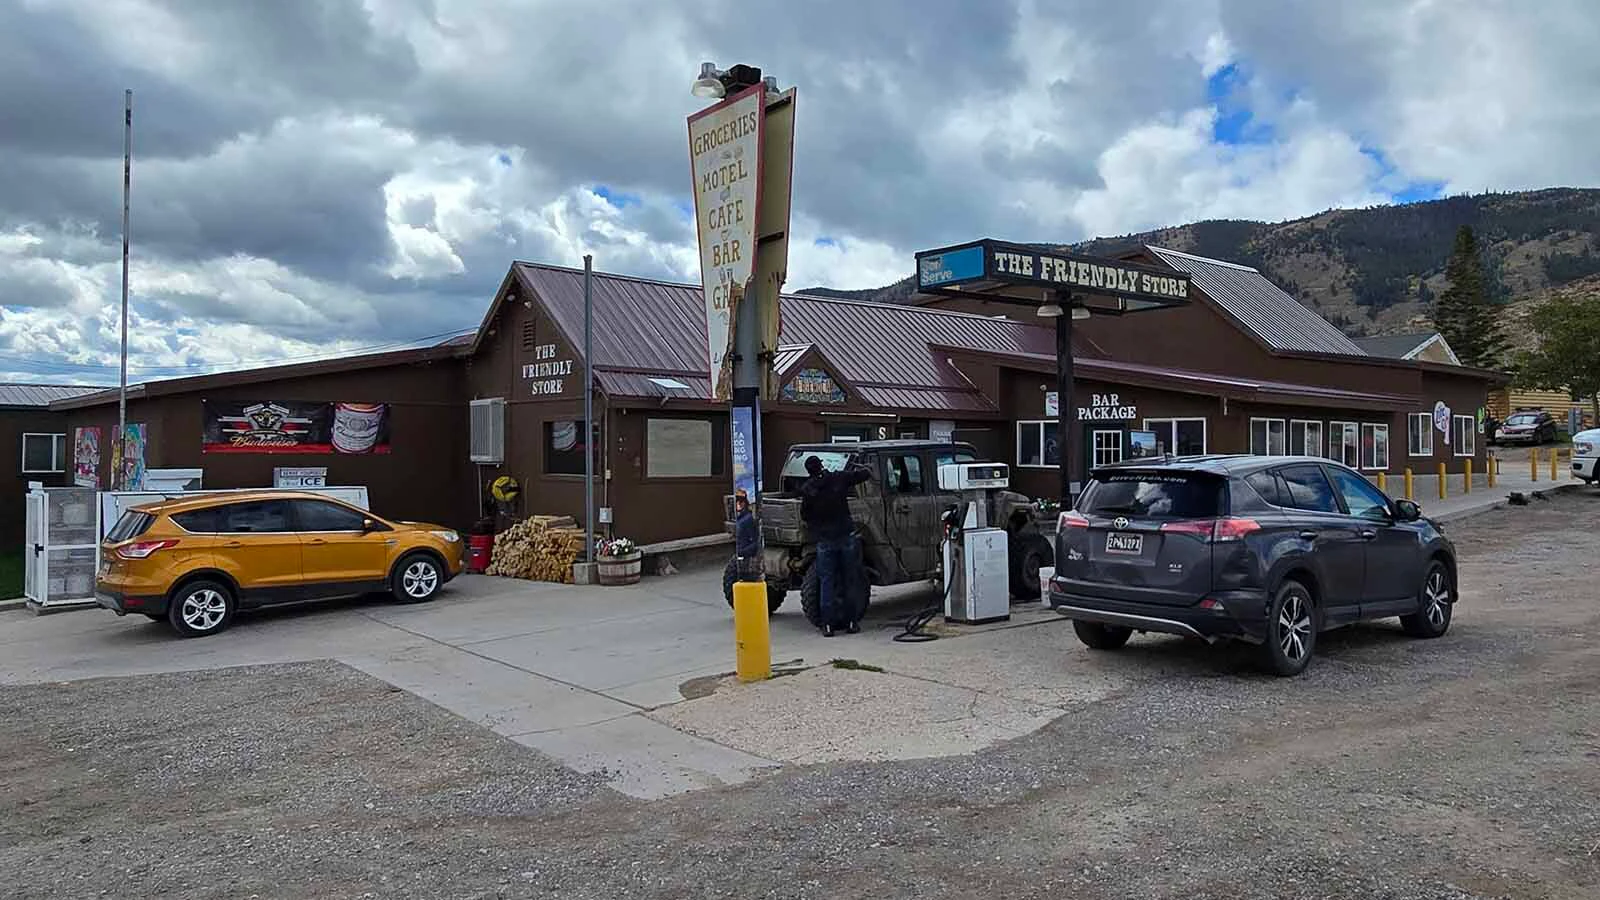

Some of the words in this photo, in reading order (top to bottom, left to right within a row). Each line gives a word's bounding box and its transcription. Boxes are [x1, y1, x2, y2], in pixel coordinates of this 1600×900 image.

[694, 111, 757, 157] GROCERIES
[702, 160, 748, 193] MOTEL
[708, 199, 744, 230] CAFE
[712, 239, 741, 268] BAR
[919, 270, 953, 287] Serve
[994, 252, 1033, 277] THE
[1040, 256, 1139, 292] FRIENDLY
[1142, 274, 1187, 298] STORE
[535, 343, 556, 360] THE
[522, 360, 573, 379] FRIENDLY
[531, 379, 564, 395] STORE
[1091, 393, 1120, 407] BAR
[1077, 405, 1137, 420] PACKAGE
[230, 435, 299, 448] Budweiser
[300, 477, 321, 486] ICE
